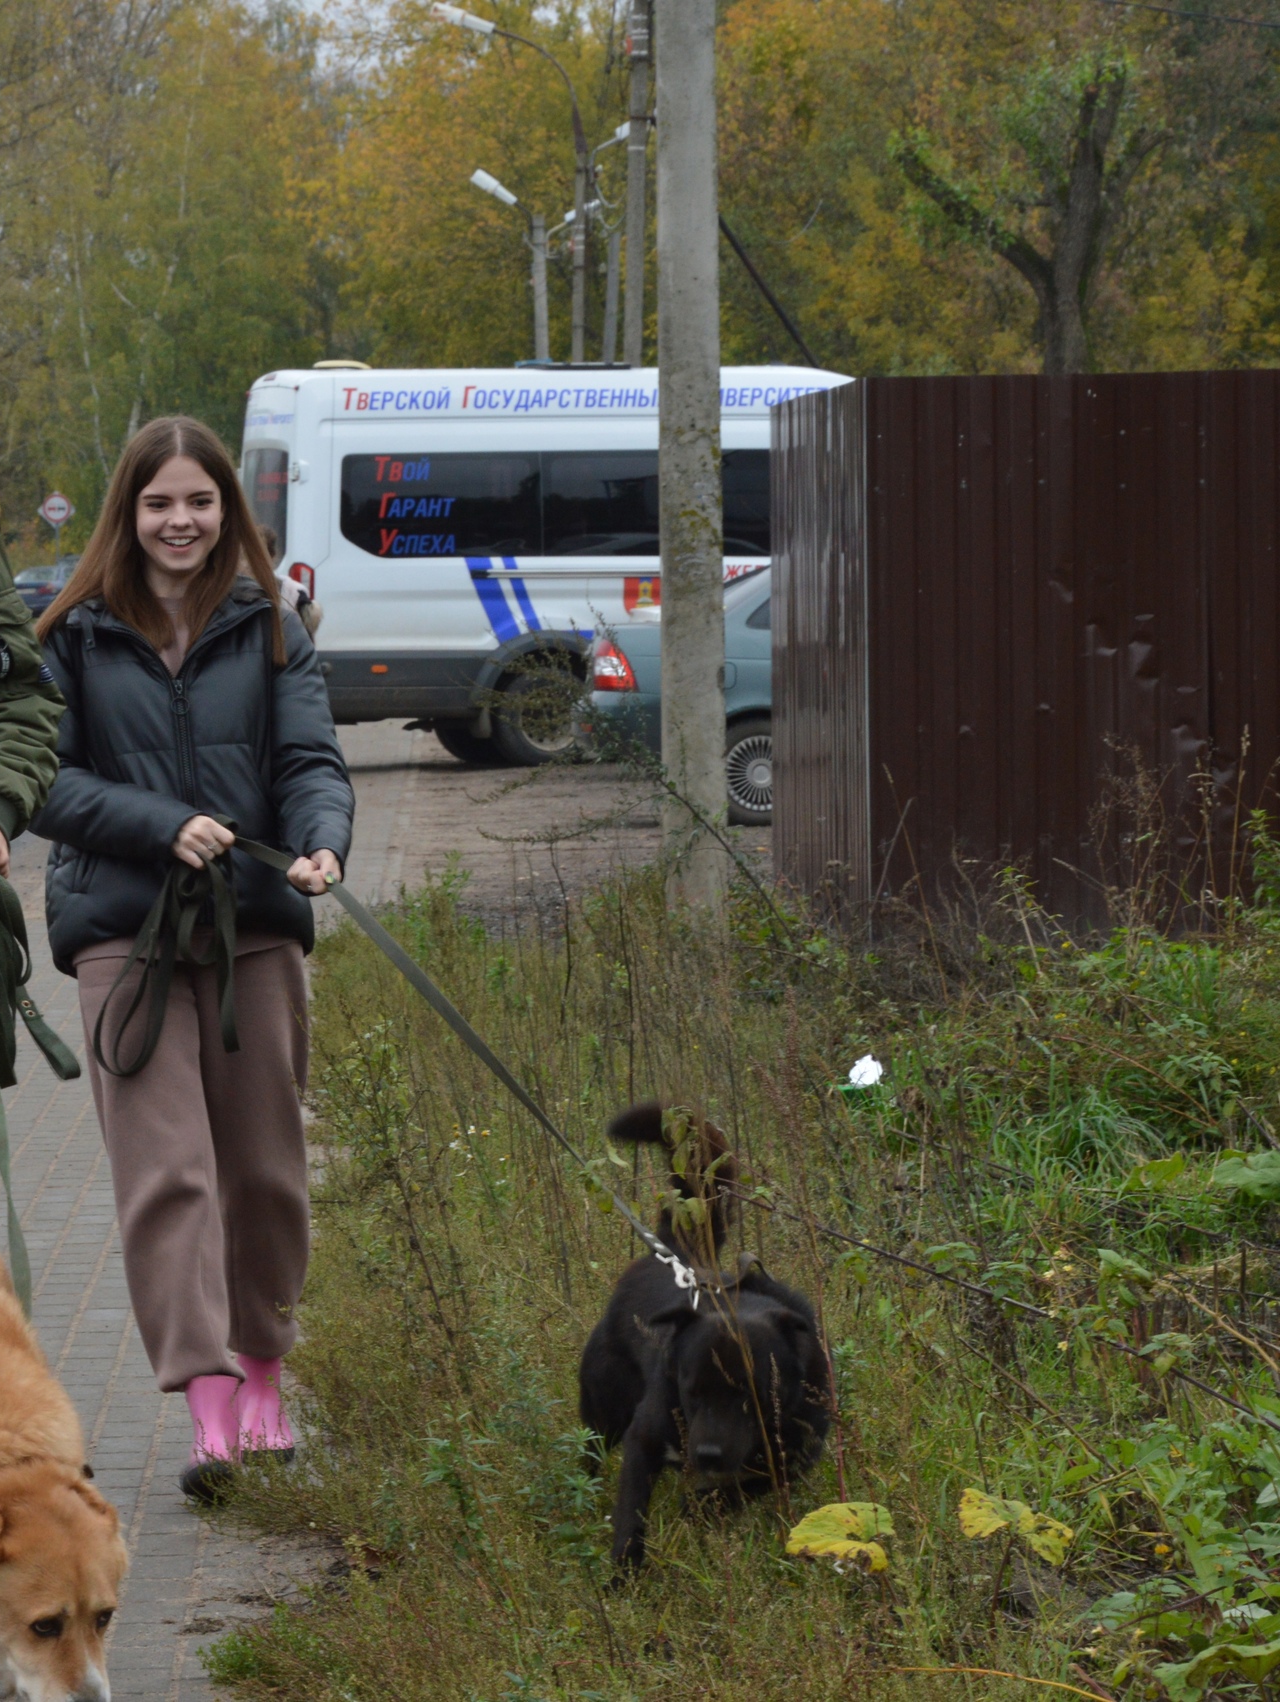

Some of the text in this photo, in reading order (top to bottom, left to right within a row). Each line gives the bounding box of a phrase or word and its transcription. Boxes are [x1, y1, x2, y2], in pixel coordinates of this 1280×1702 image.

[342, 386, 451, 411] ТВЕРСКОЙ
[461, 385, 658, 412] ГОСУДАРСТВЕННЫ
[375, 456, 431, 482] ТВОЙ
[378, 492, 456, 518] ГАРАНТ
[379, 529, 456, 555] УСПЕХА
